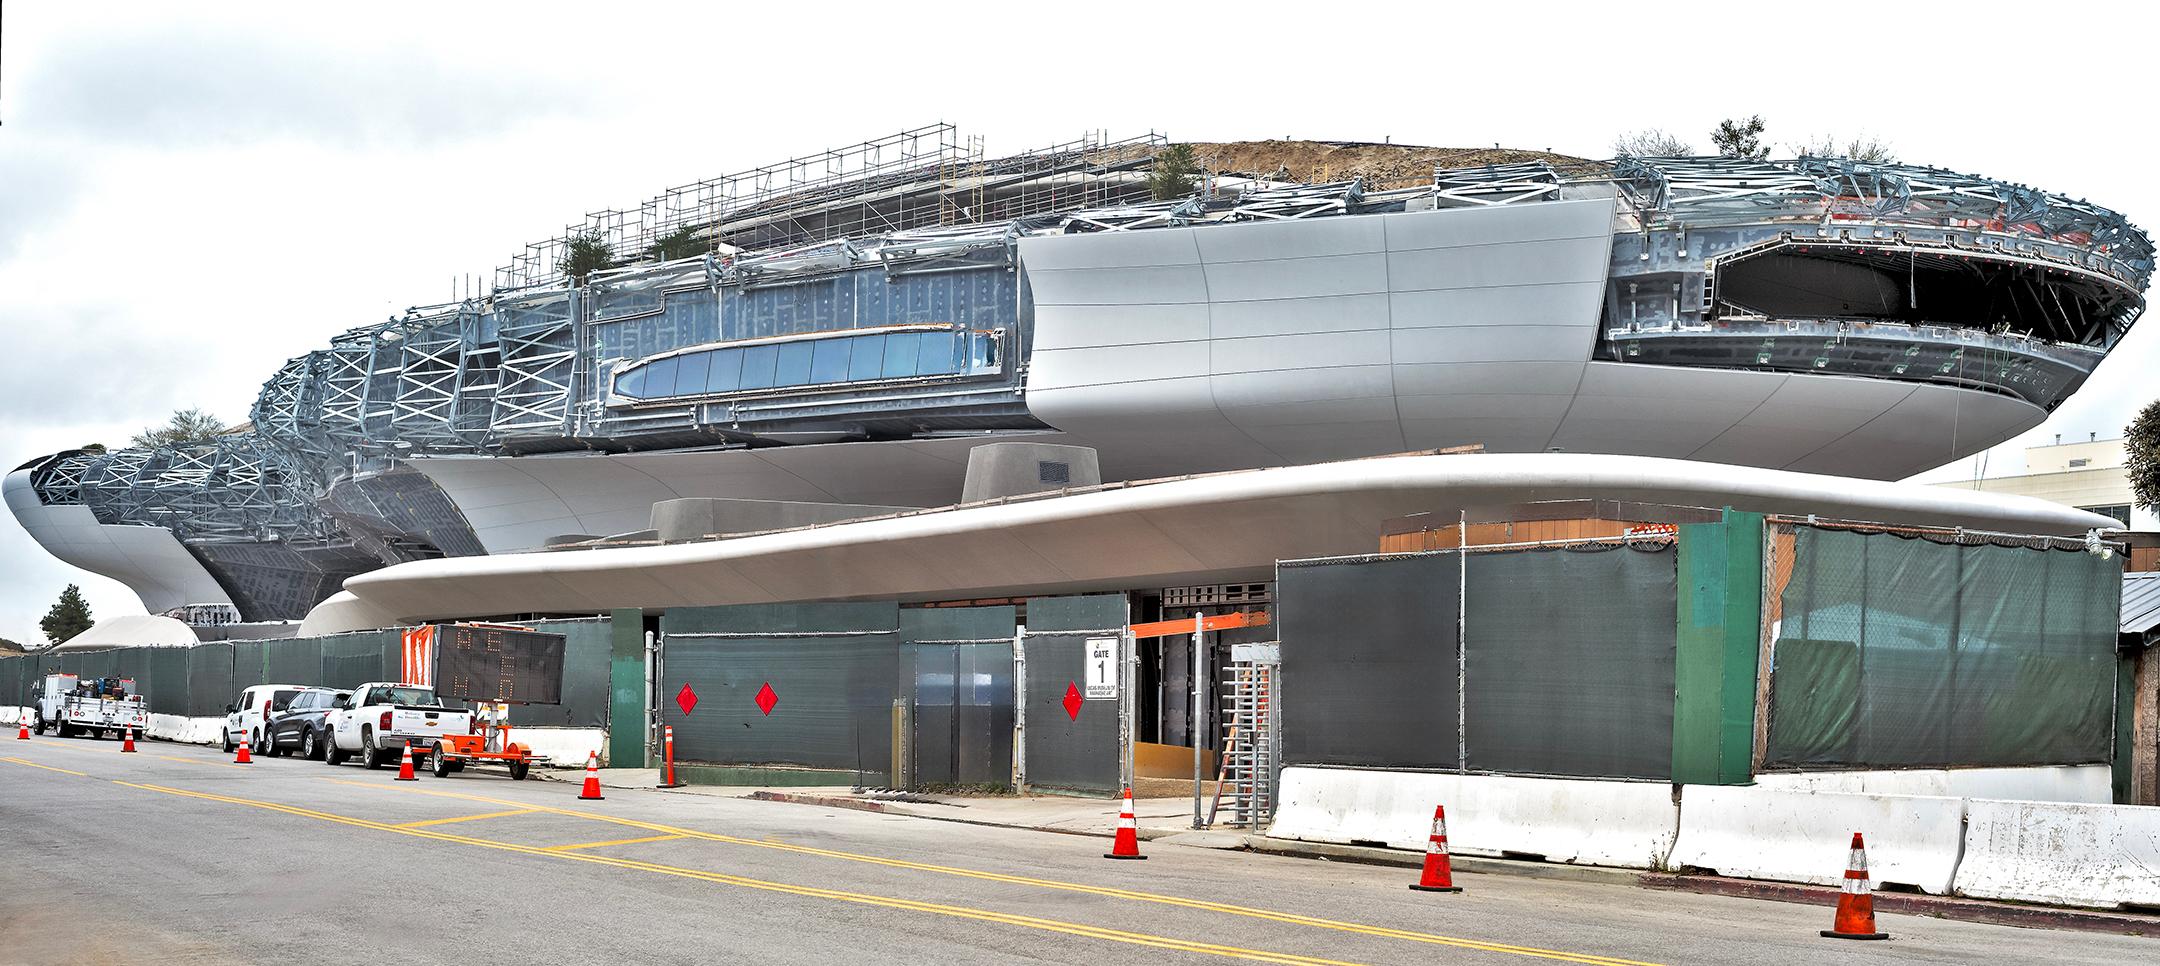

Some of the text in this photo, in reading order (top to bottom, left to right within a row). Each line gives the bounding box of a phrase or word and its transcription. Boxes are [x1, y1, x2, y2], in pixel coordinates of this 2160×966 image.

[457, 629, 471, 650] A
[1094, 650, 1109, 659] GATE
[1098, 660, 1104, 683] 1
[454, 676, 468, 696] H
